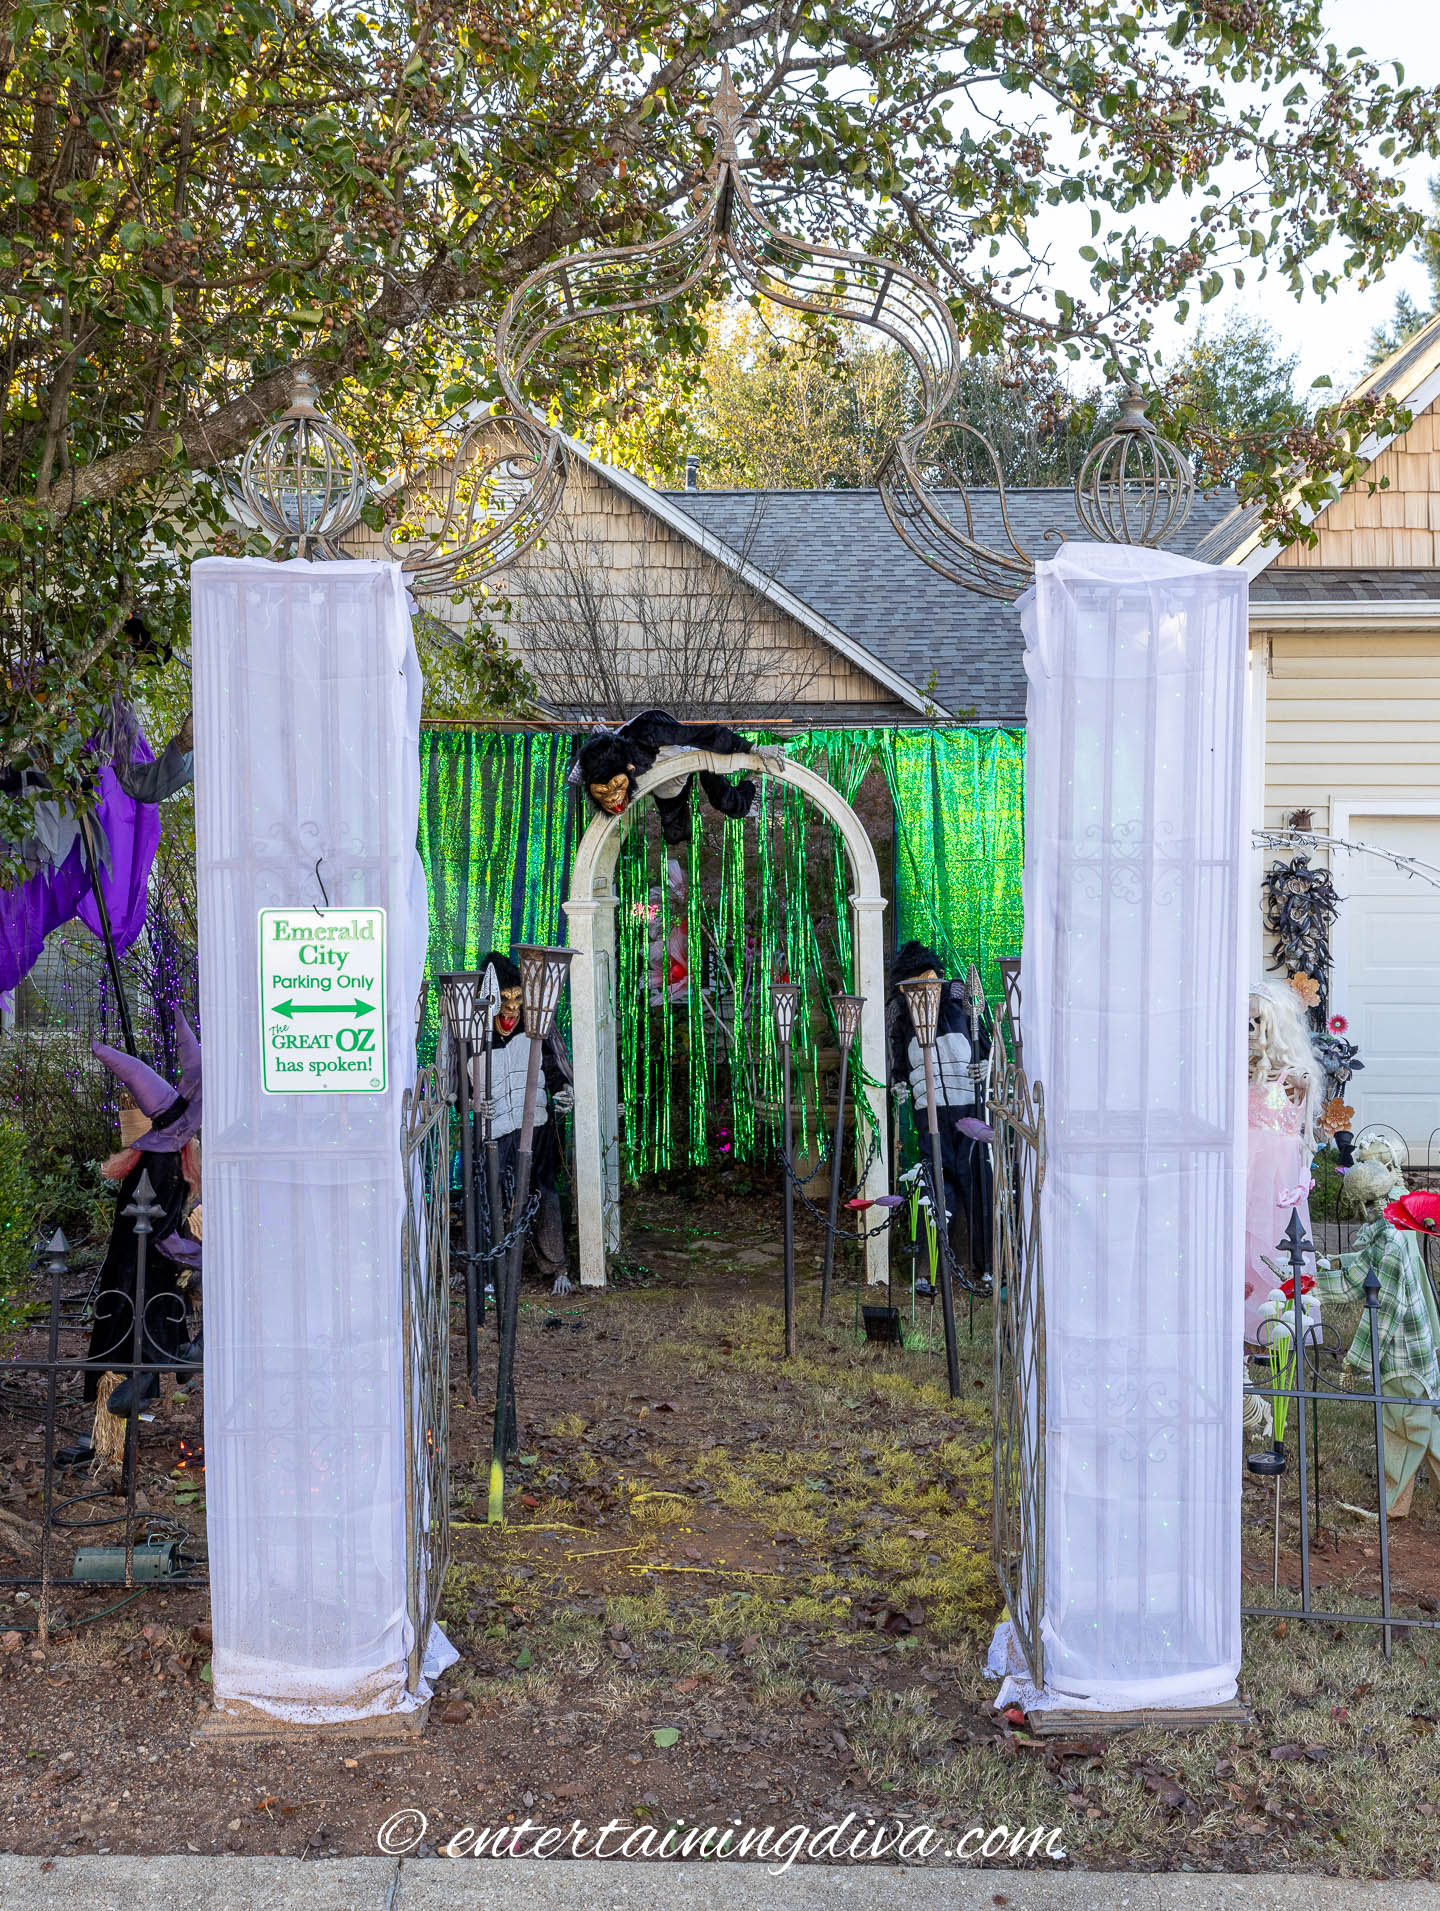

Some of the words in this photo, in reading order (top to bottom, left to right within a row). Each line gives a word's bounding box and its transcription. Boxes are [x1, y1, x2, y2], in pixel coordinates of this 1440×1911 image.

[272, 920, 375, 941] Emerald
[298, 944, 350, 971] City
[272, 975, 332, 992] Parking
[337, 975, 375, 991] Only
[269, 1023, 290, 1036] The
[271, 1034, 334, 1050] GREAT
[335, 1028, 376, 1052] OZ
[275, 1056, 304, 1072] has
[309, 1056, 373, 1077] spoken!
